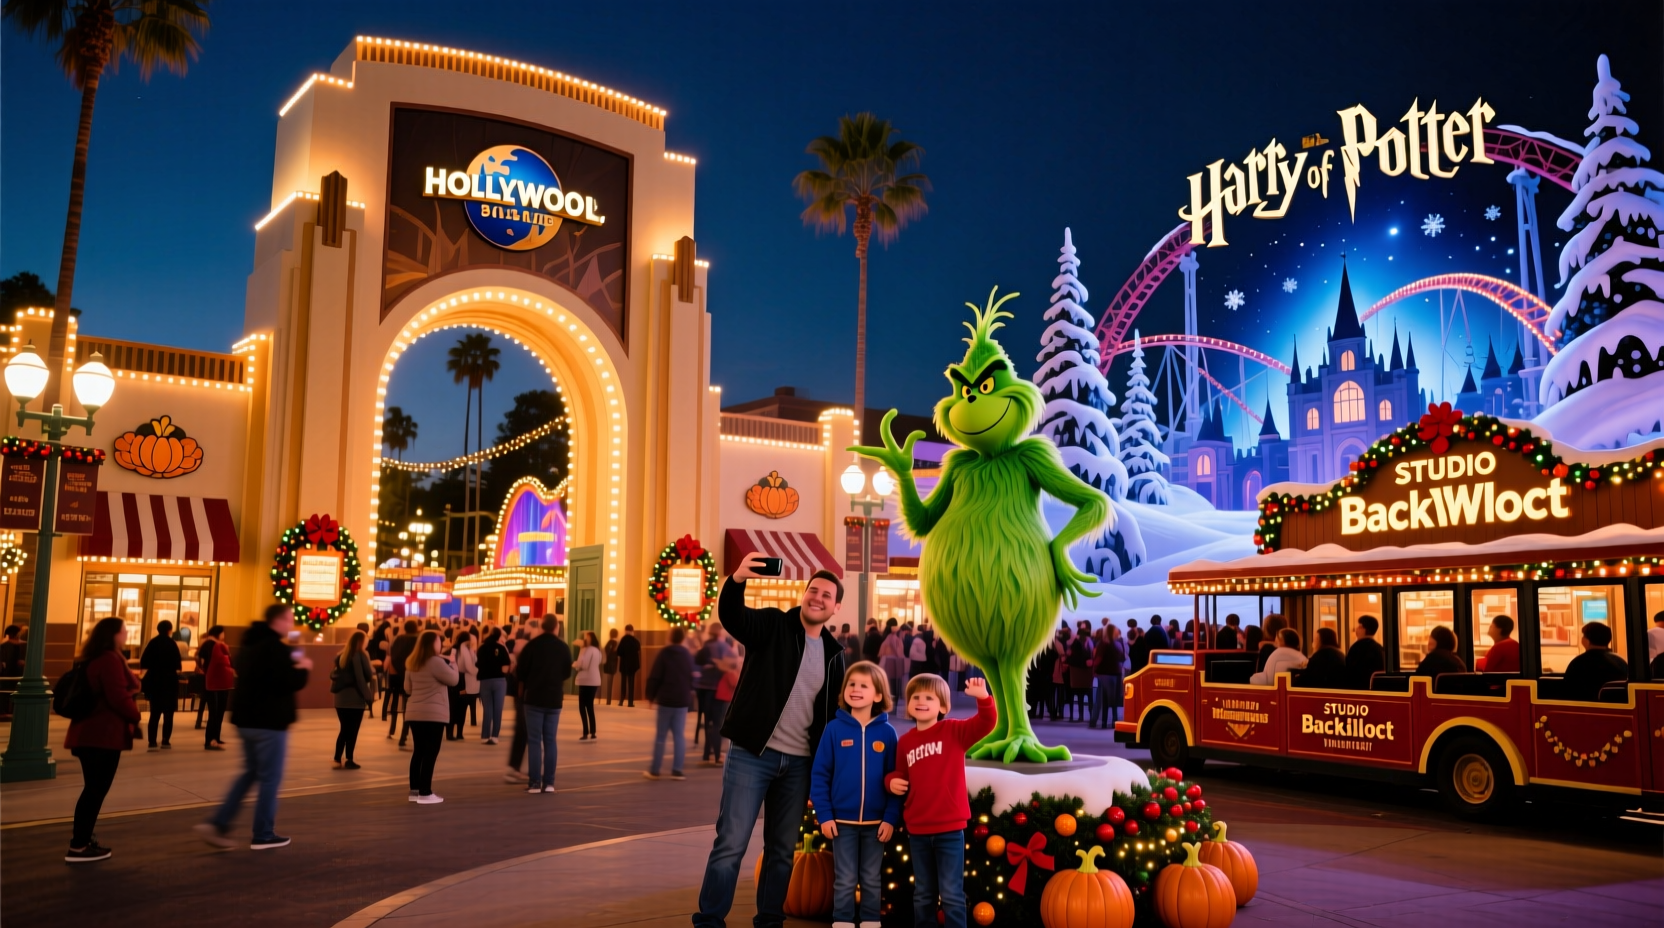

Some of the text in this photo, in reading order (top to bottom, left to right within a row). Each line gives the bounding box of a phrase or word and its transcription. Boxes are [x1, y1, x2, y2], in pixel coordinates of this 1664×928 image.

[1178, 96, 1496, 248] Harry of Potter
[1394, 451, 1497, 485] STUDIO
[1323, 702, 1369, 717] STUDIO
